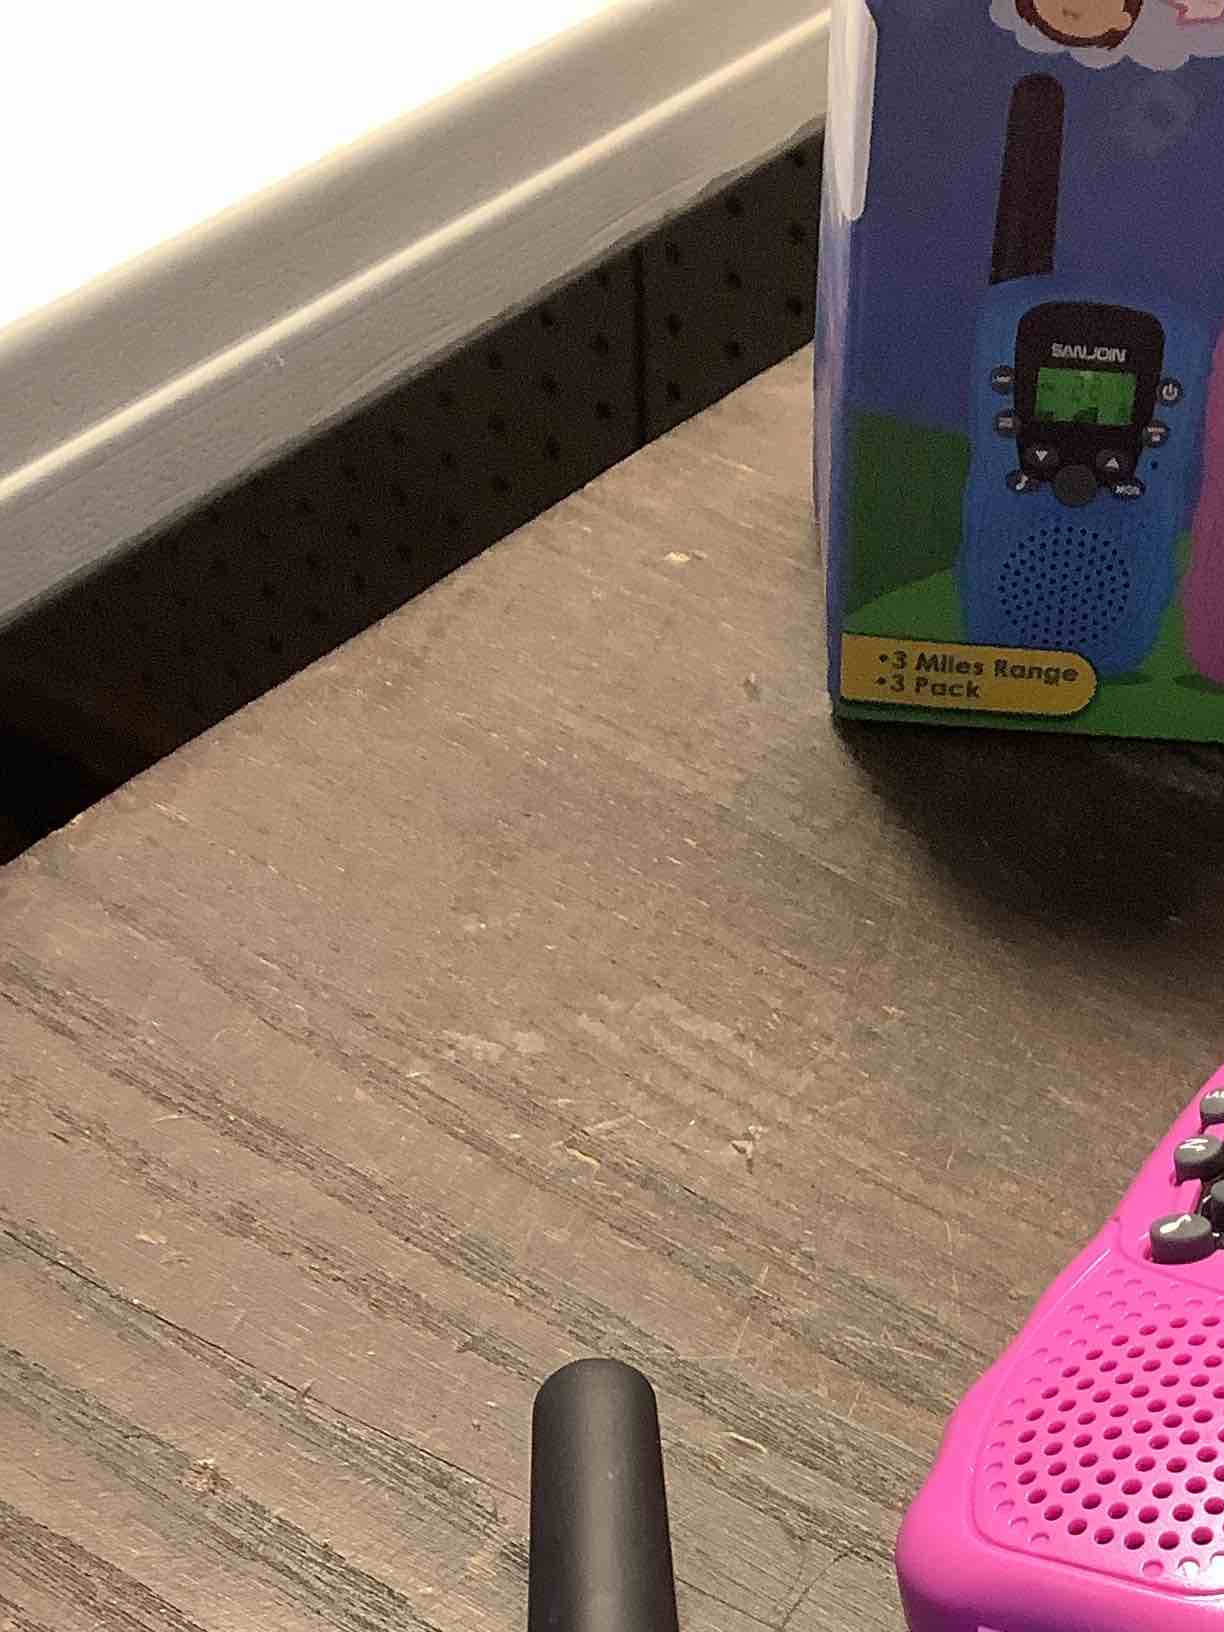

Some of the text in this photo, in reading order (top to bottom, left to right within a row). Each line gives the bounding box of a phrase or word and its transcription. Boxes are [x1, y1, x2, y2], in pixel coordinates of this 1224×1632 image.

[914, 652, 984, 676] Miles
[994, 658, 1079, 686] Range
[914, 676, 981, 699] Pack
